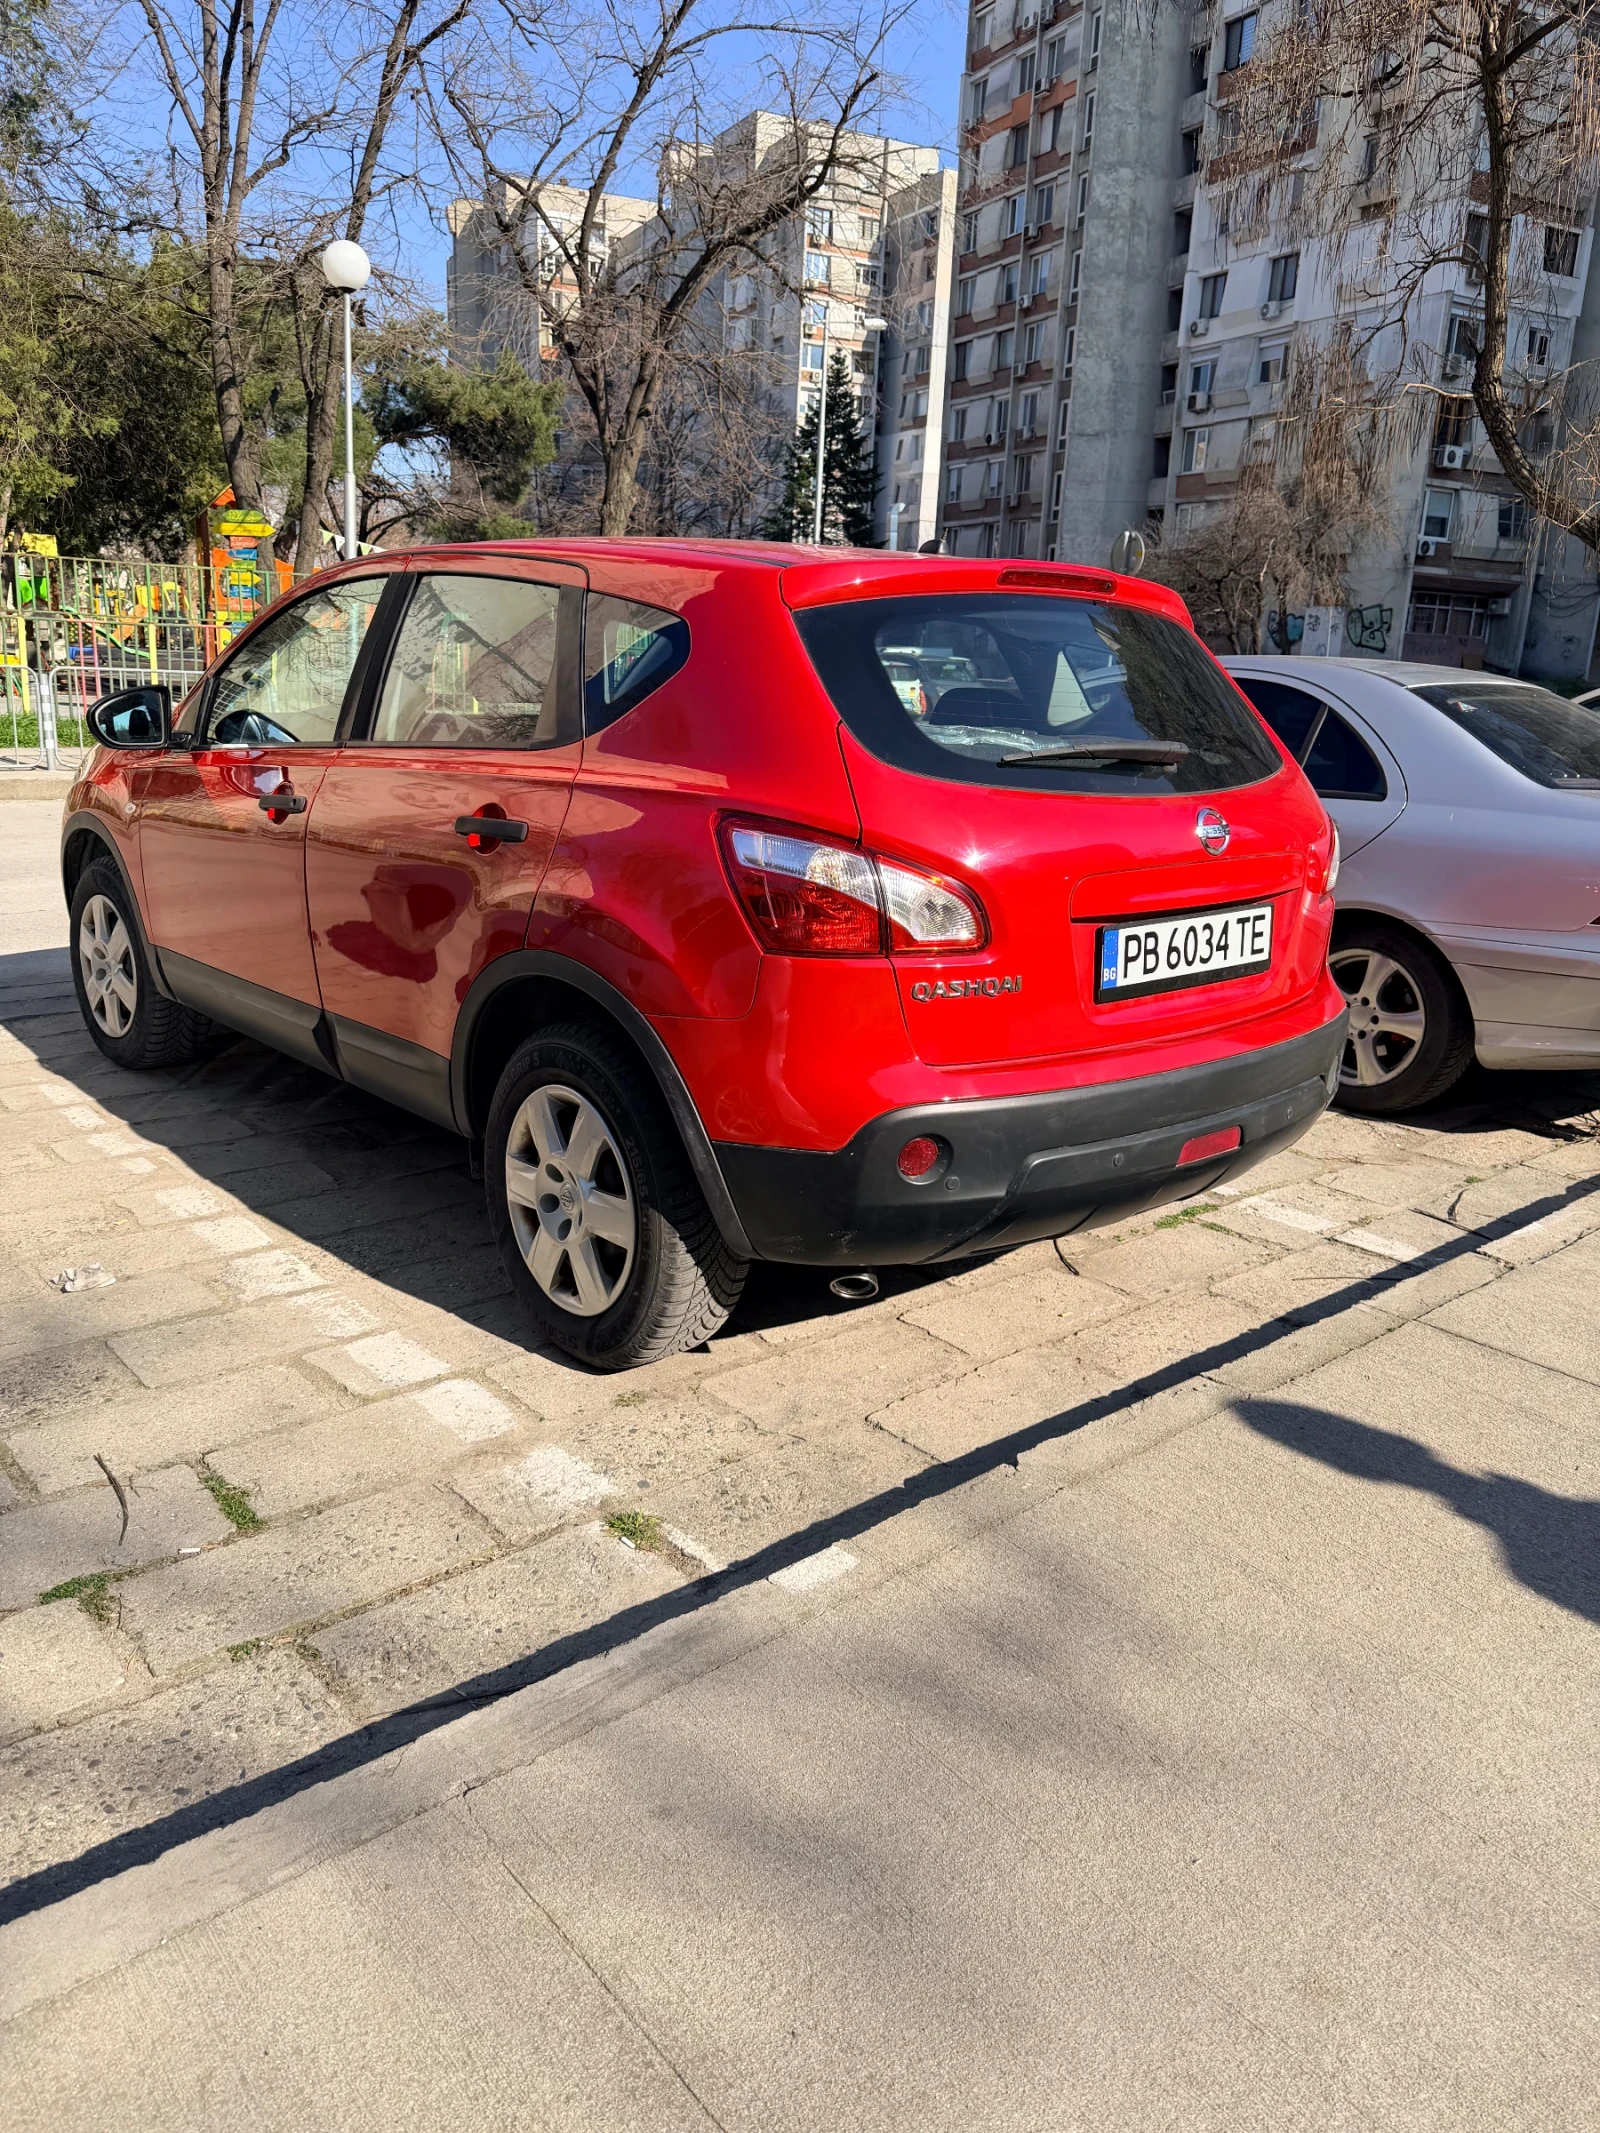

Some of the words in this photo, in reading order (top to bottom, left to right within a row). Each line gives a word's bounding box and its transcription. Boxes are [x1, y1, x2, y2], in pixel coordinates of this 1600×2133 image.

[1123, 931, 1160, 979] PB
[1166, 920, 1230, 971] 6034
[1236, 914, 1266, 957] TE
[910, 974, 1022, 1003] QASHQAI
[1103, 967, 1117, 982] BG
[625, 1135, 649, 1198] 215/65
